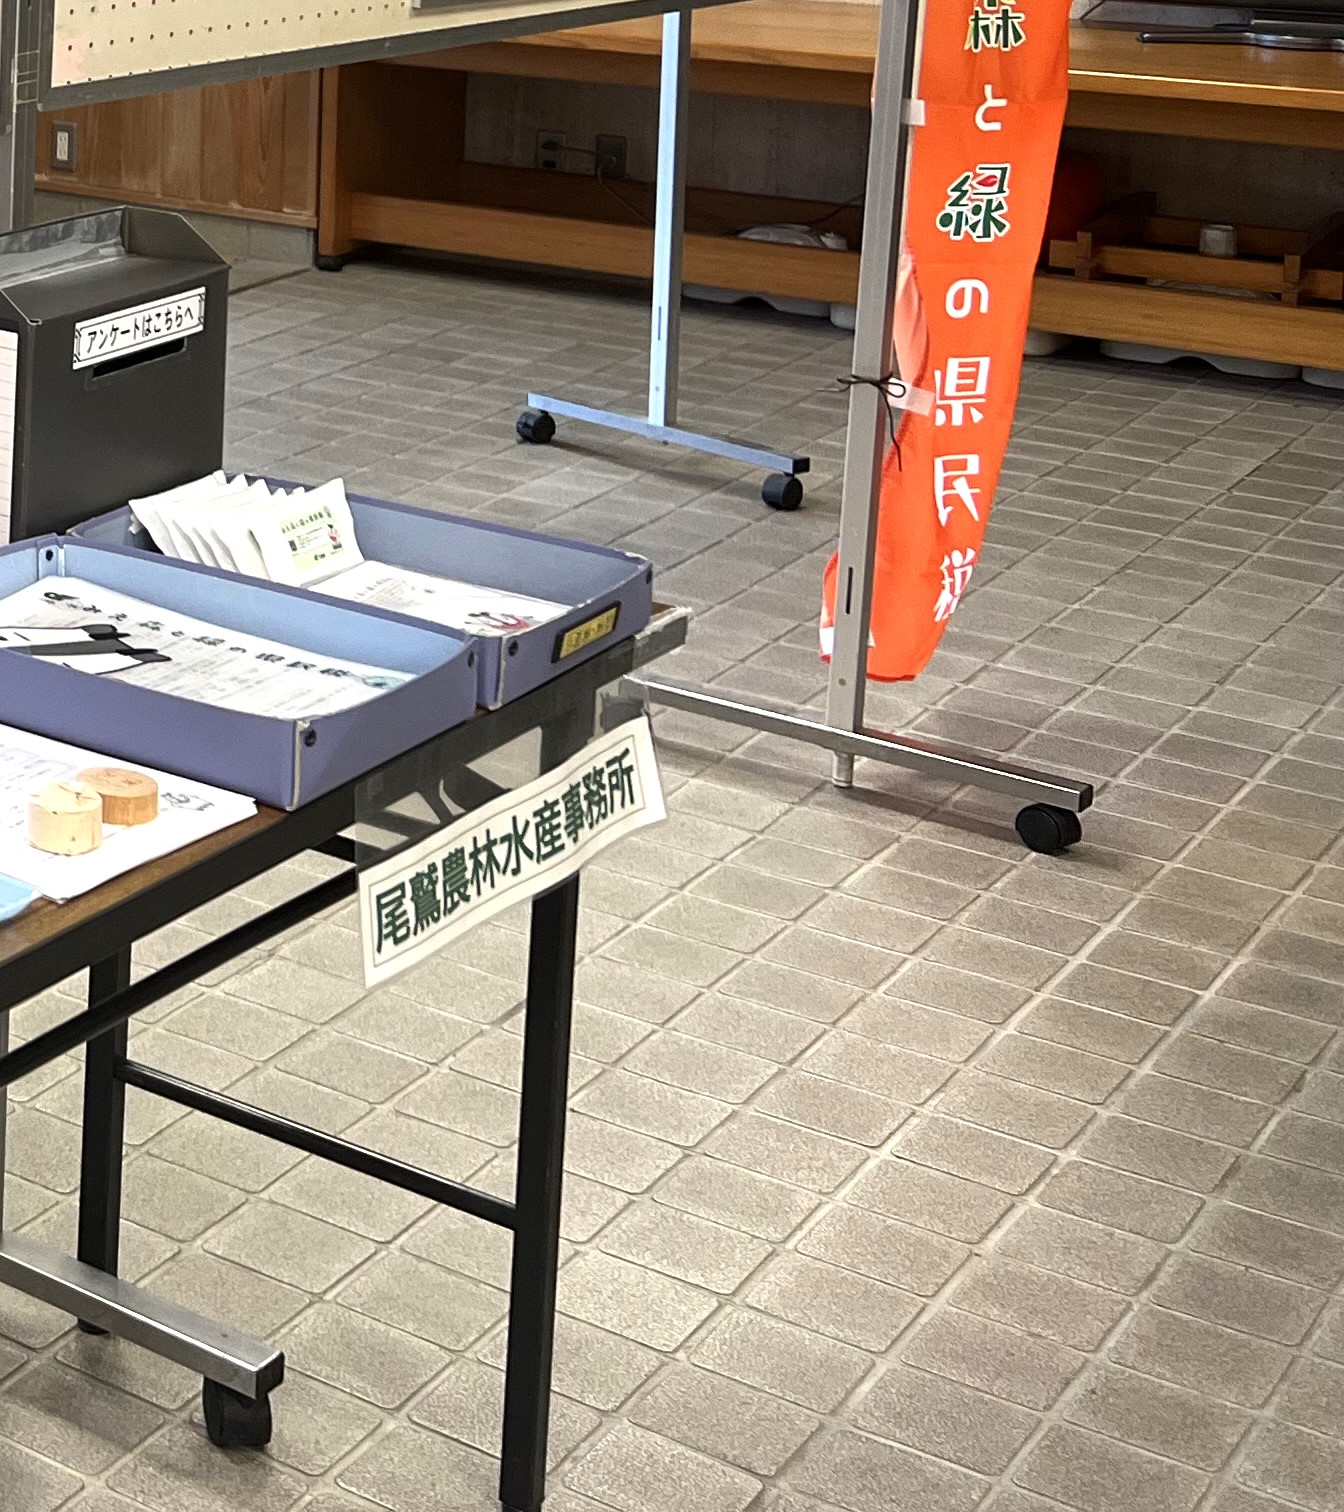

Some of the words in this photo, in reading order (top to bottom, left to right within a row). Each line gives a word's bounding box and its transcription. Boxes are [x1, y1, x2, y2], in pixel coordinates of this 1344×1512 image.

[87, 307, 194, 354] アンケートはこちらへ
[376, 748, 634, 954] 尾鷲農林水産事務所
